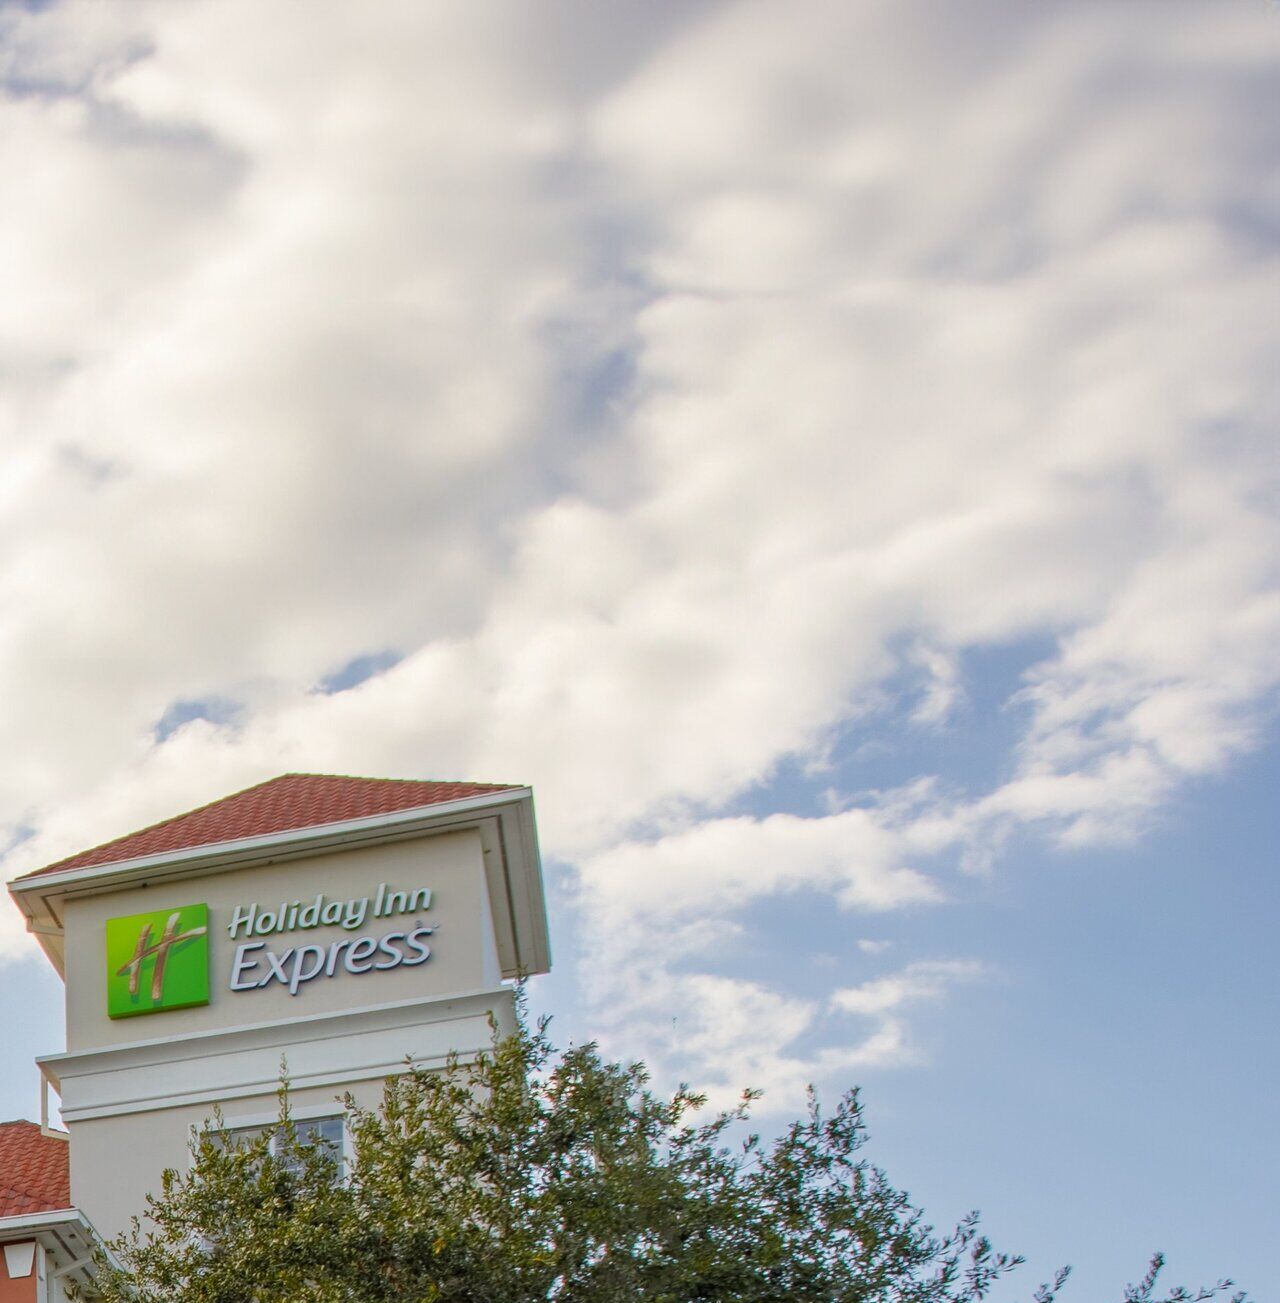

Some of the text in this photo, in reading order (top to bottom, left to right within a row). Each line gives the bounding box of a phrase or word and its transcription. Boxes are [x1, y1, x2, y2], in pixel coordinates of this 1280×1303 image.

[227, 882, 432, 940] Holiday Inn
[230, 927, 433, 996] Express
